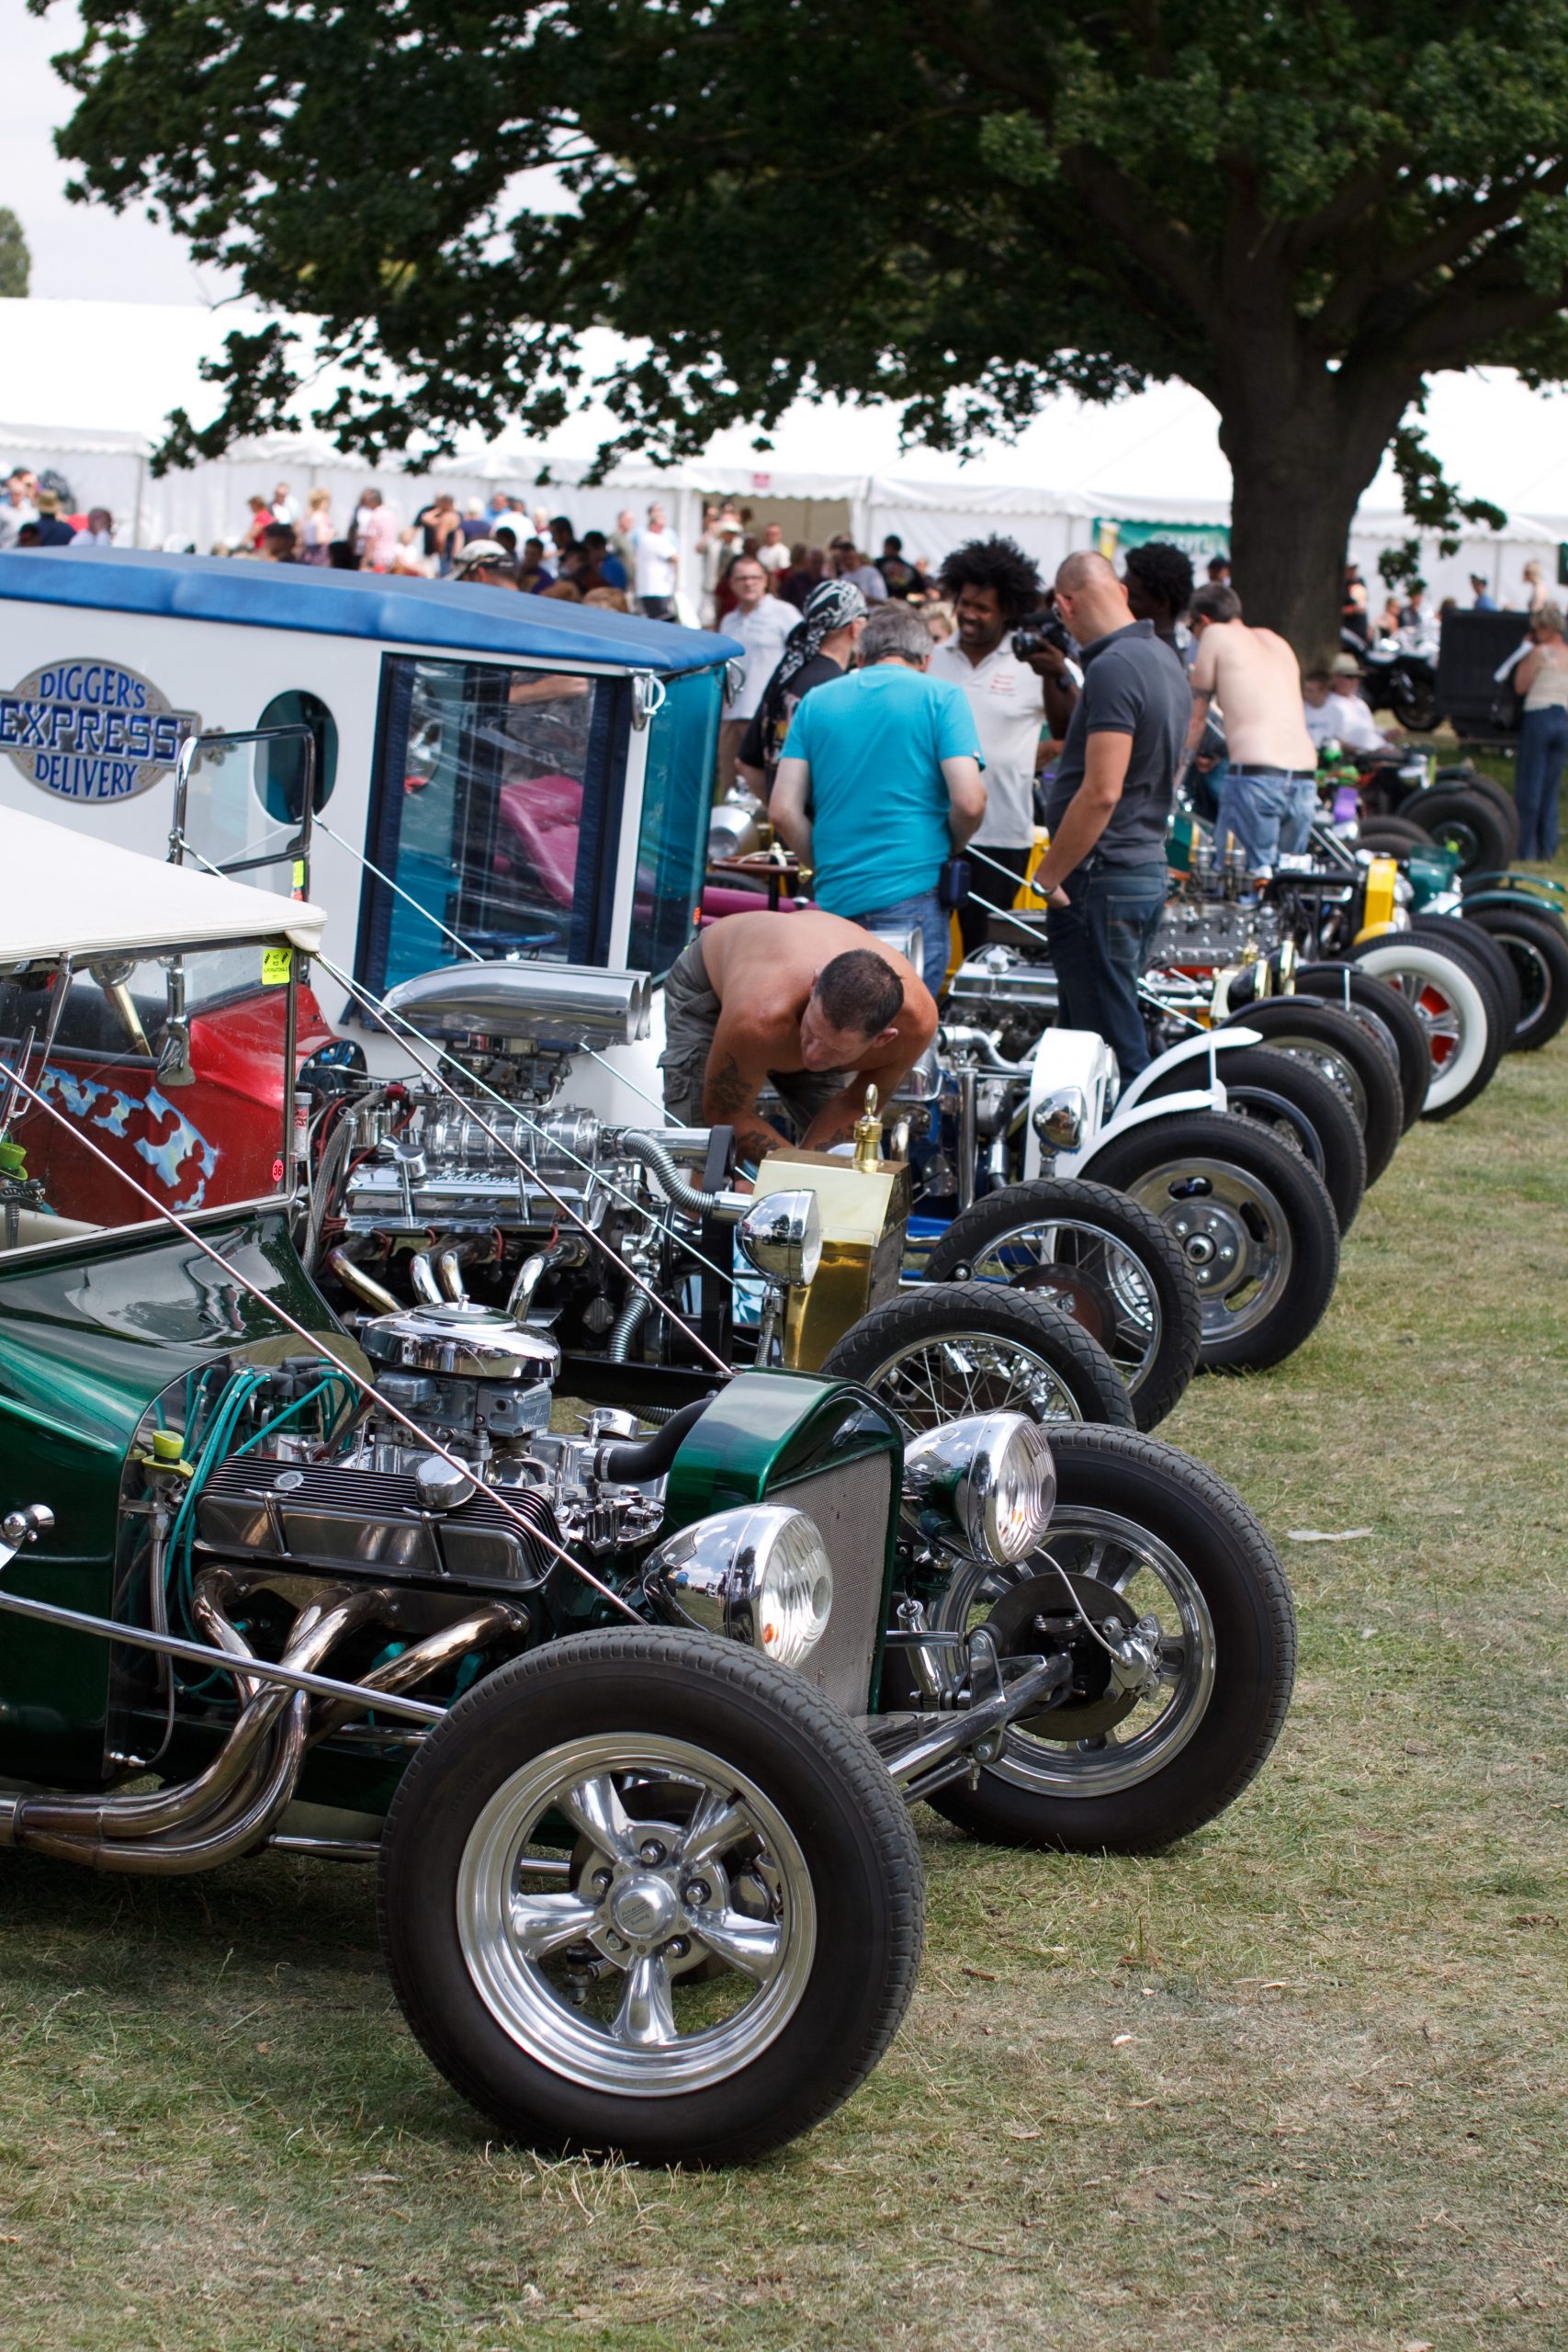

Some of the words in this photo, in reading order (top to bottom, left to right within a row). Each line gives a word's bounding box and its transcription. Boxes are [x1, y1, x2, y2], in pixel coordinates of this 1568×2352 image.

[39, 665, 146, 709] DIGGER'S
[0, 699, 179, 764] EXPRESS
[35, 754, 138, 798] DELIVERY
[274, 1165, 283, 1176] 36
